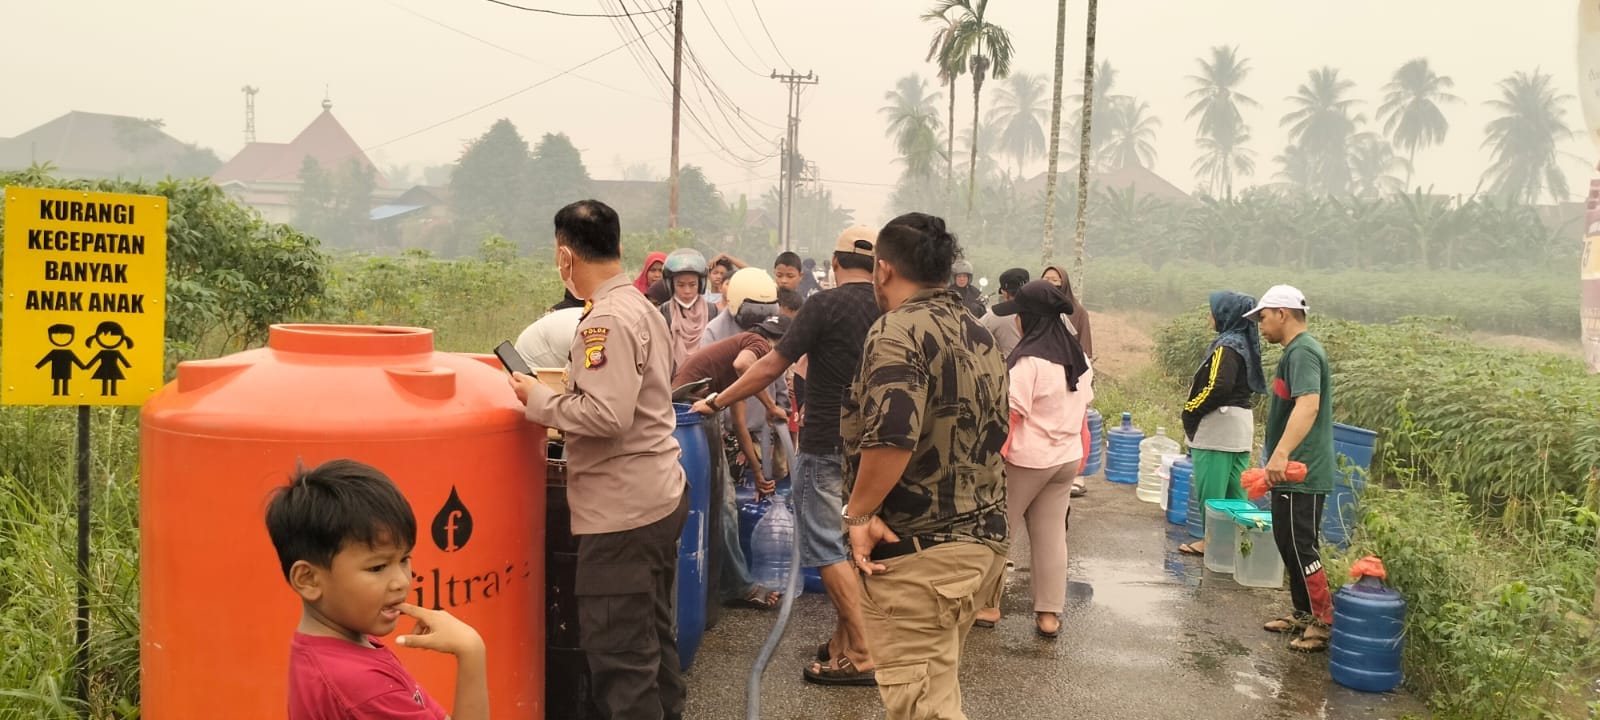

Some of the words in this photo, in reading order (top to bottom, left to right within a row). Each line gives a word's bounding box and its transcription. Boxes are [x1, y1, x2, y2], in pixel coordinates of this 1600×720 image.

[40, 199, 135, 224] KURANGI
[28, 229, 145, 255] KECEPATAN
[45, 260, 128, 283] BANYAK
[25, 290, 83, 311] ANAK
[88, 293, 145, 314] ANAK
[443, 509, 463, 551] f
